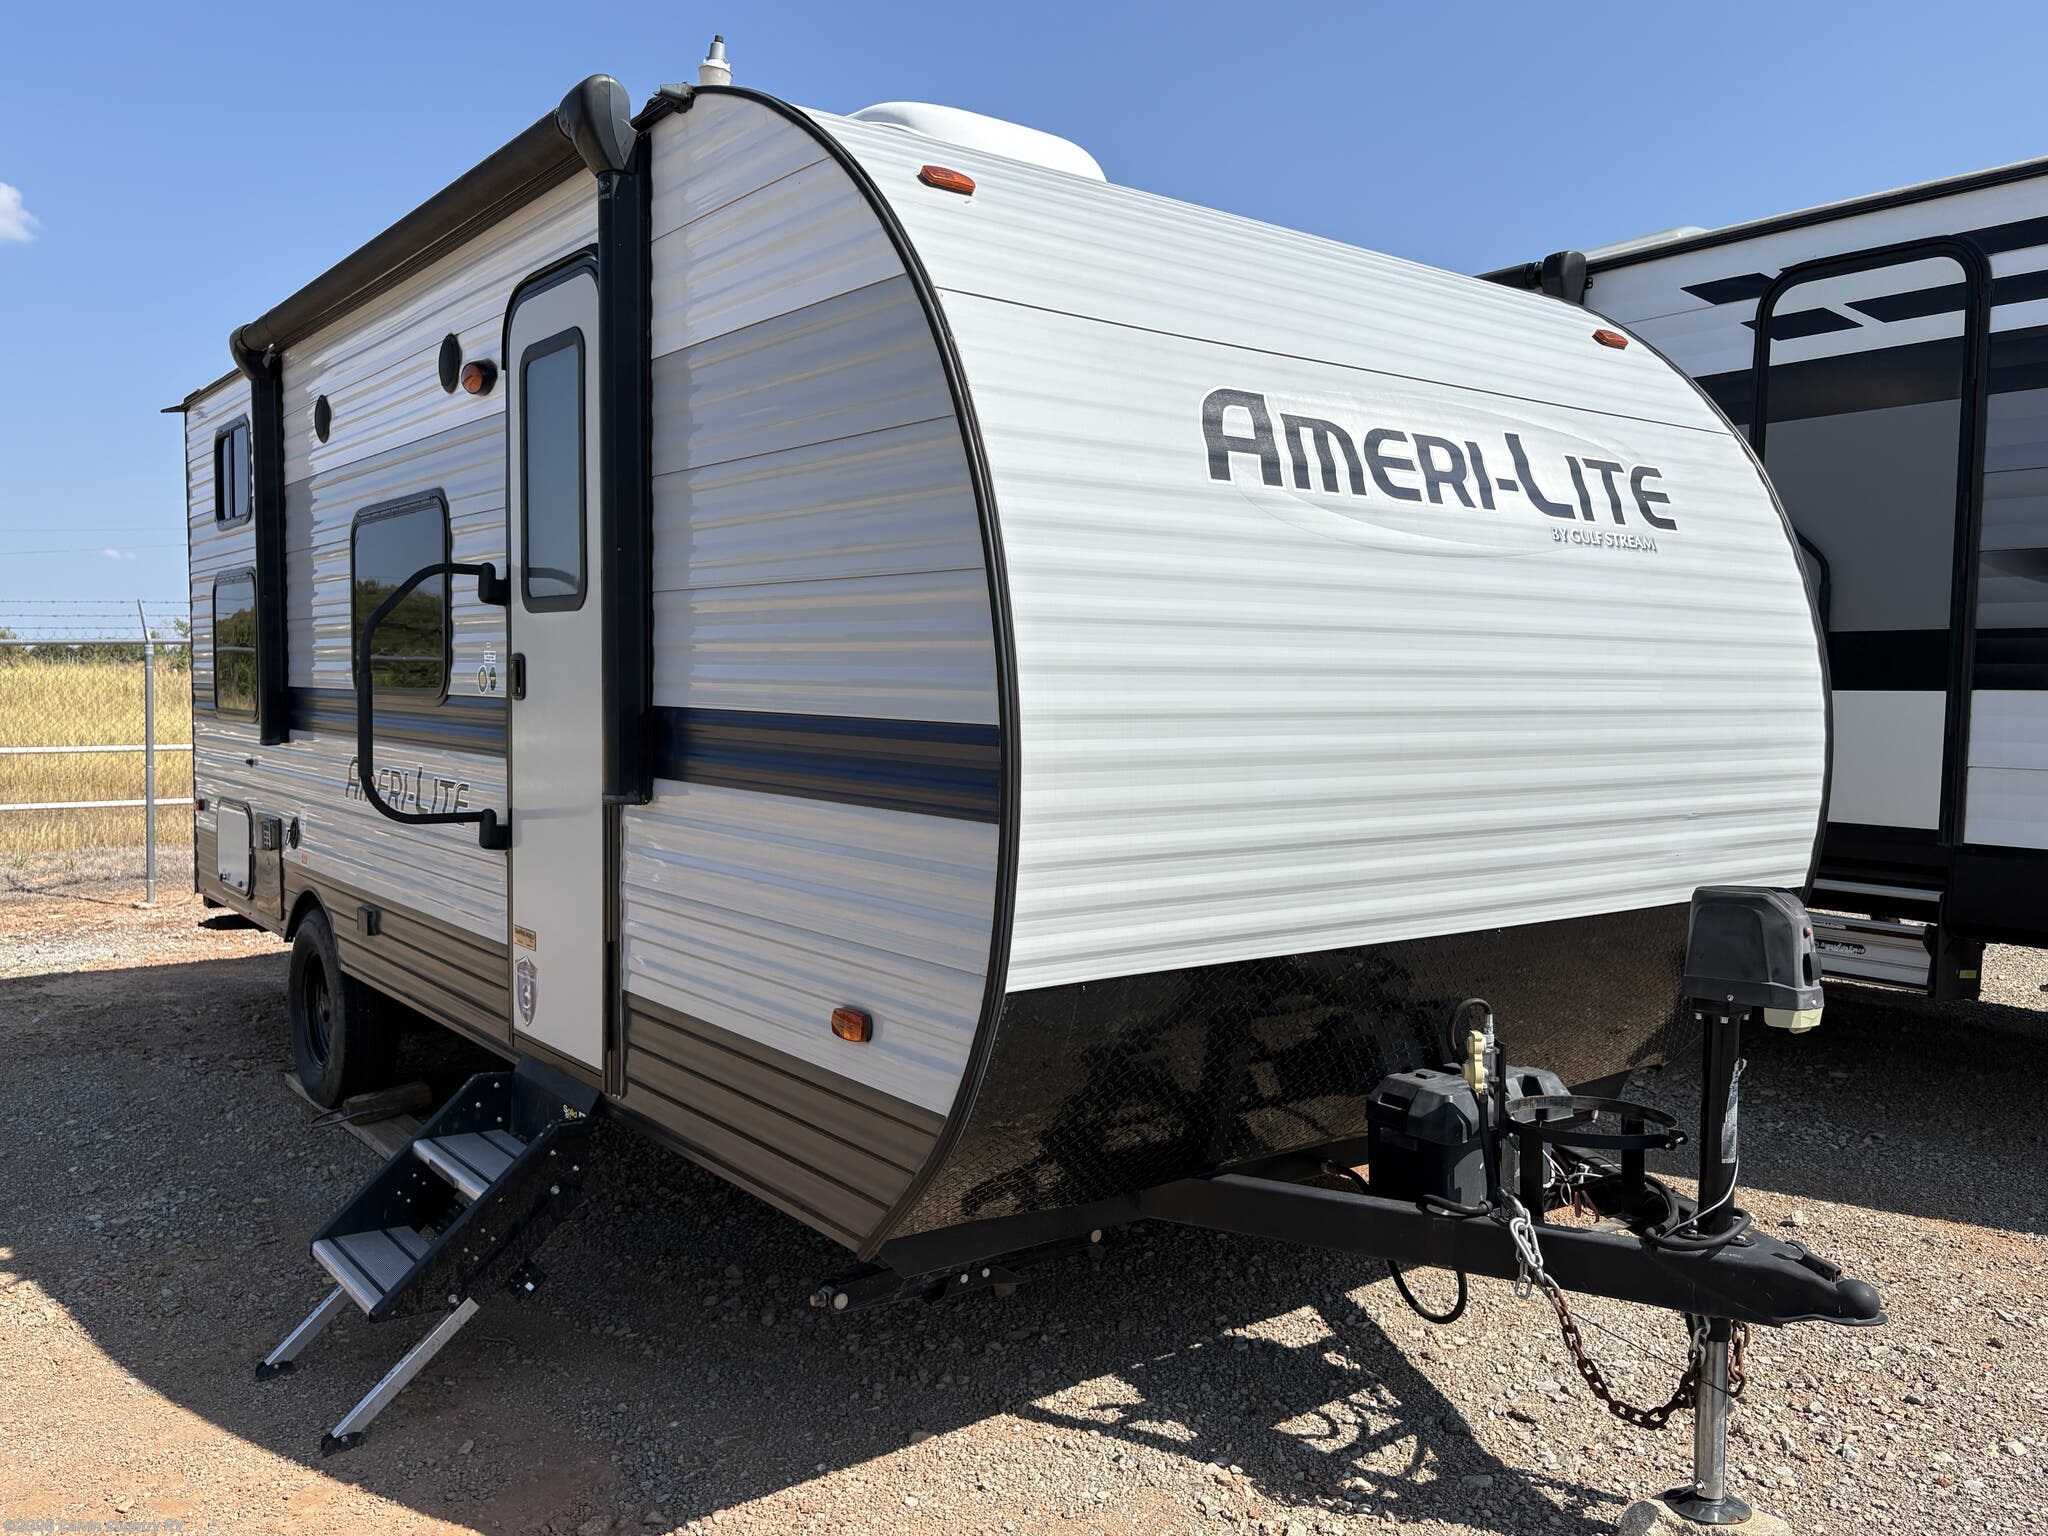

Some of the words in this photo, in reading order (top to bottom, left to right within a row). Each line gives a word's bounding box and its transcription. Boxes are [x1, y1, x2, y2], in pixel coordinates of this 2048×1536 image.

[1201, 388, 1678, 531] AMERI-LITE
[1551, 527, 1568, 543] BY
[1570, 528, 1603, 546] GULF
[1604, 532, 1657, 552] STREAM
